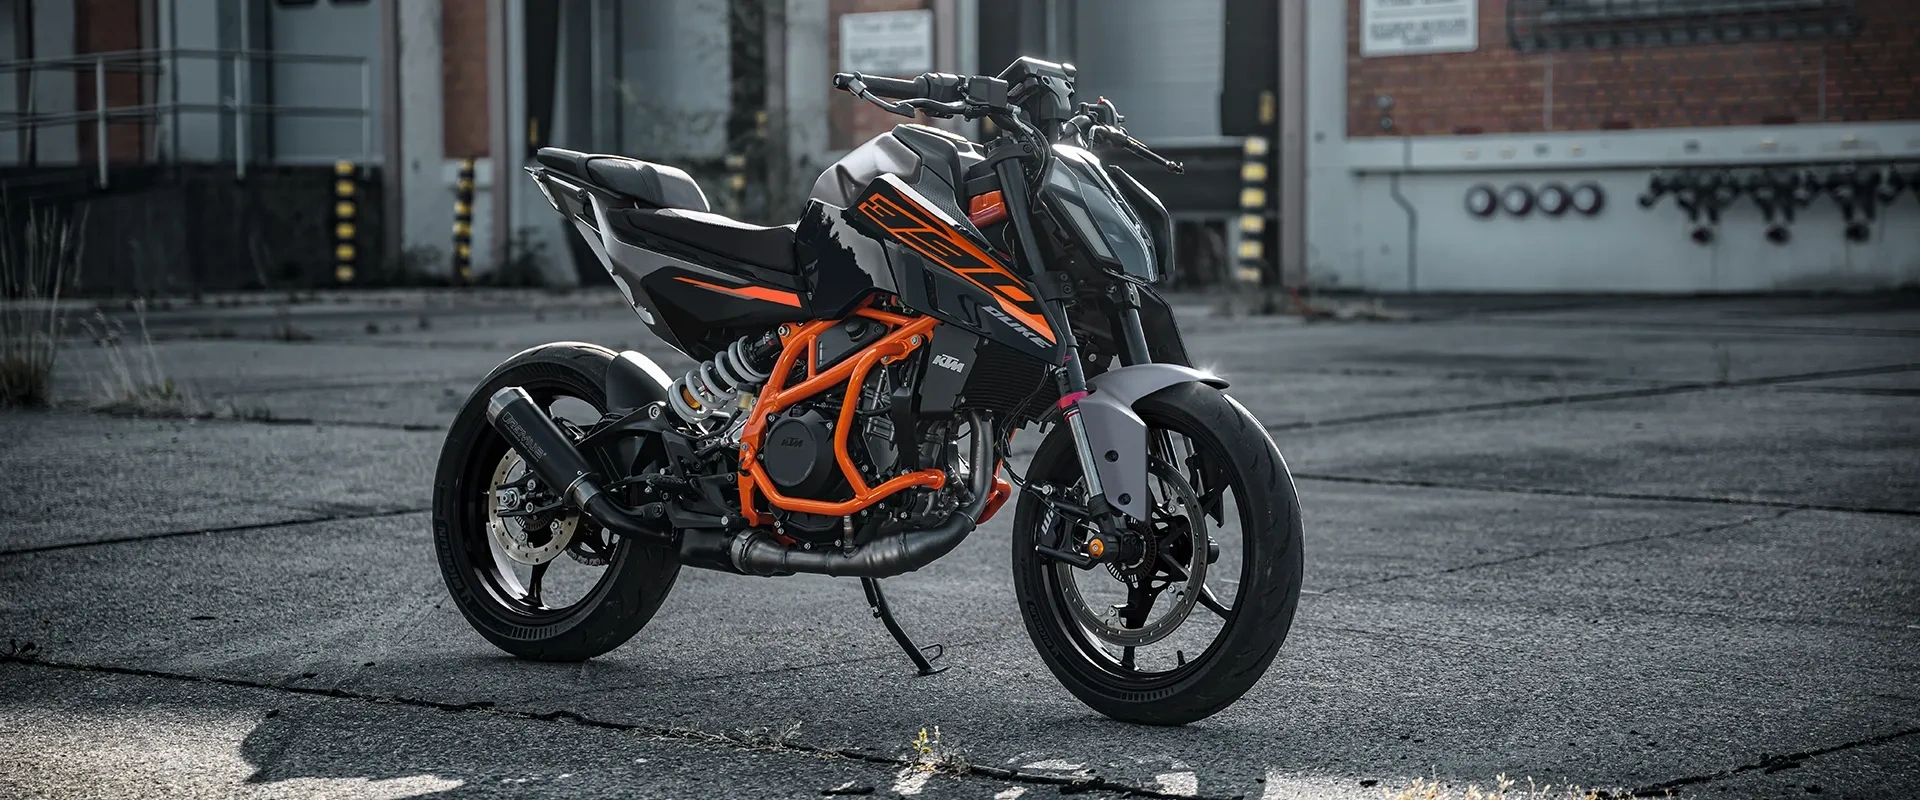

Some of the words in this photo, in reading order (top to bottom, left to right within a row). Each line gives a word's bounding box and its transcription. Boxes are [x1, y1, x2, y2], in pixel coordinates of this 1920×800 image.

[859, 194, 1044, 314] 390
[982, 305, 1053, 348] DUKE
[932, 353, 965, 373] KTM
[506, 415, 544, 459] REMUS
[781, 437, 804, 448] KTM
[438, 525, 463, 590] MICHELIN
